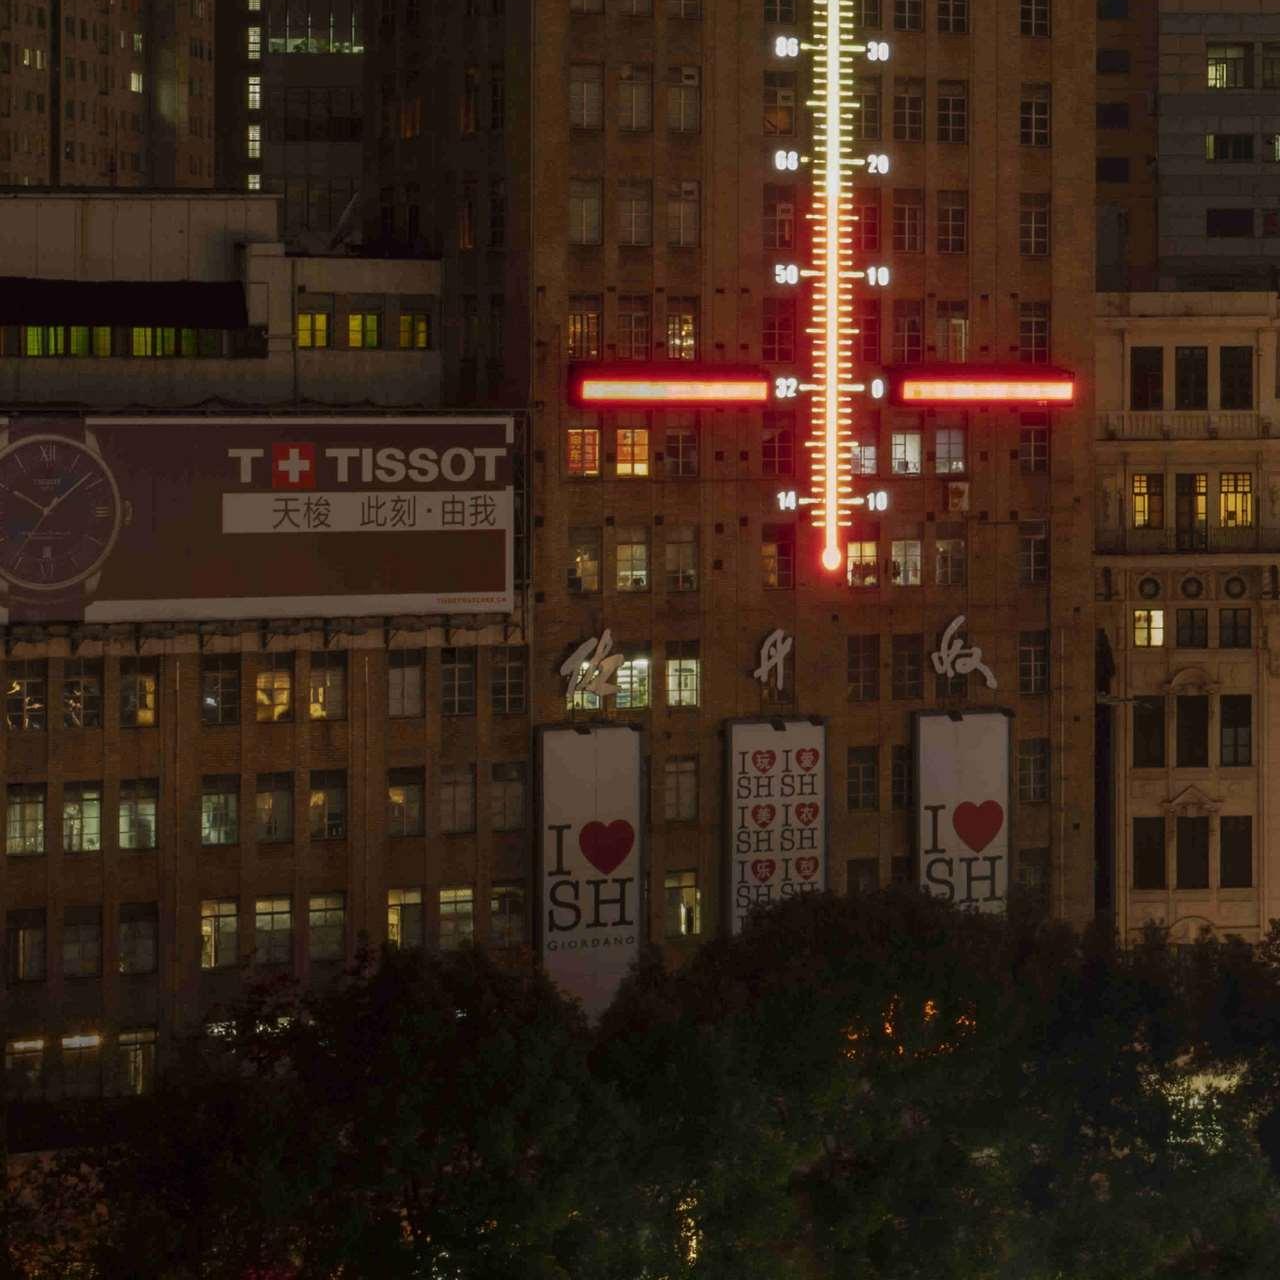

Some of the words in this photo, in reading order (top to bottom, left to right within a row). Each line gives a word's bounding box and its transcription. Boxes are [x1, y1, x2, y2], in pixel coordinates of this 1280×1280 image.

[867, 41, 890, 62] 30
[867, 154, 890, 174] 20
[774, 265, 799, 285] 50
[866, 266, 890, 286] 10
[775, 378, 798, 398] 32
[871, 378, 884, 399] 0
[324, 446, 507, 483] TISSOT
[272, 495, 331, 530] 天梭
[776, 490, 797, 511] 14
[738, 751, 749, 775] I
[782, 749, 793, 773] I
[737, 775, 775, 799] SH
[780, 773, 818, 798] SH
[738, 806, 749, 830] I
[782, 803, 793, 827] I
[780, 828, 818, 852] SH
[924, 804, 947, 854] I
[548, 823, 572, 877] I
[736, 830, 774, 854] SH
[737, 860, 749, 884] I
[781, 858, 793, 882] I
[924, 856, 1003, 904] SH
[548, 876, 635, 933] SH
[547, 934, 636, 951] GIORDANO
